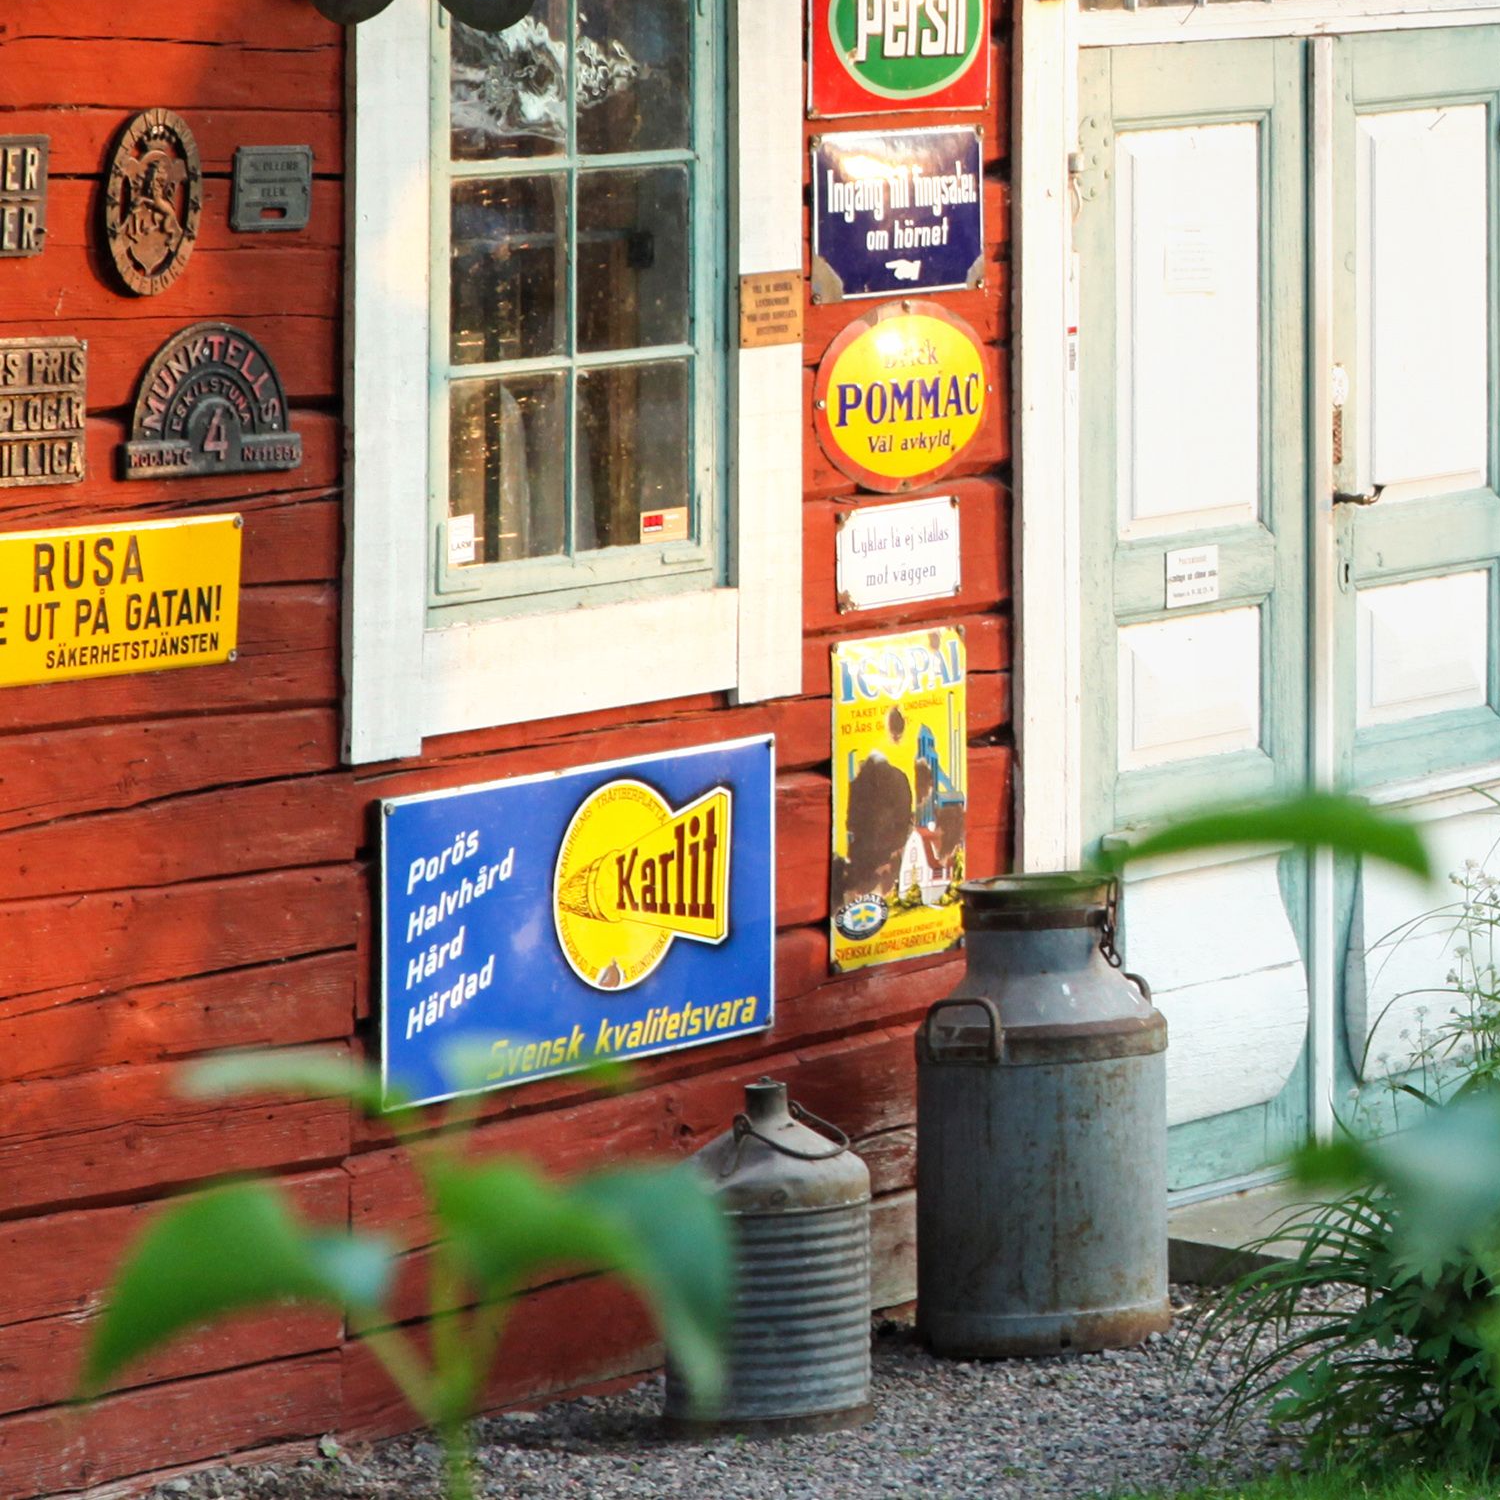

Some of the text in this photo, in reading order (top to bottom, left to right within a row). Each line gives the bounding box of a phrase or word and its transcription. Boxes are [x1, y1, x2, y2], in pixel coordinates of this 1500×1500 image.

[0, 147, 39, 191] ER
[866, 217, 949, 250] om hörnet
[31, 350, 85, 385] PRIS
[143, 335, 279, 432] MUNKTELLS
[172, 378, 250, 432] ESKILSTUNA
[835, 373, 979, 427] POMMAC
[203, 407, 228, 460] 4
[868, 435, 893, 453] Väl
[33, 535, 144, 593] RUSA
[24, 601, 61, 642] UT
[75, 588, 110, 637] PÅ
[125, 585, 222, 631] GATAN!
[46, 632, 219, 669] SÄKERHETSTJÄNSTEN
[840, 641, 961, 701] ICOPAL
[841, 724, 851, 735] 10
[406, 829, 480, 895] Porös
[616, 806, 717, 920] Karlit
[406, 848, 515, 944] Halvhård
[405, 927, 466, 991] Hård
[405, 956, 495, 1040] Härdad
[486, 996, 757, 1080] Svensk kvalitetsvara
